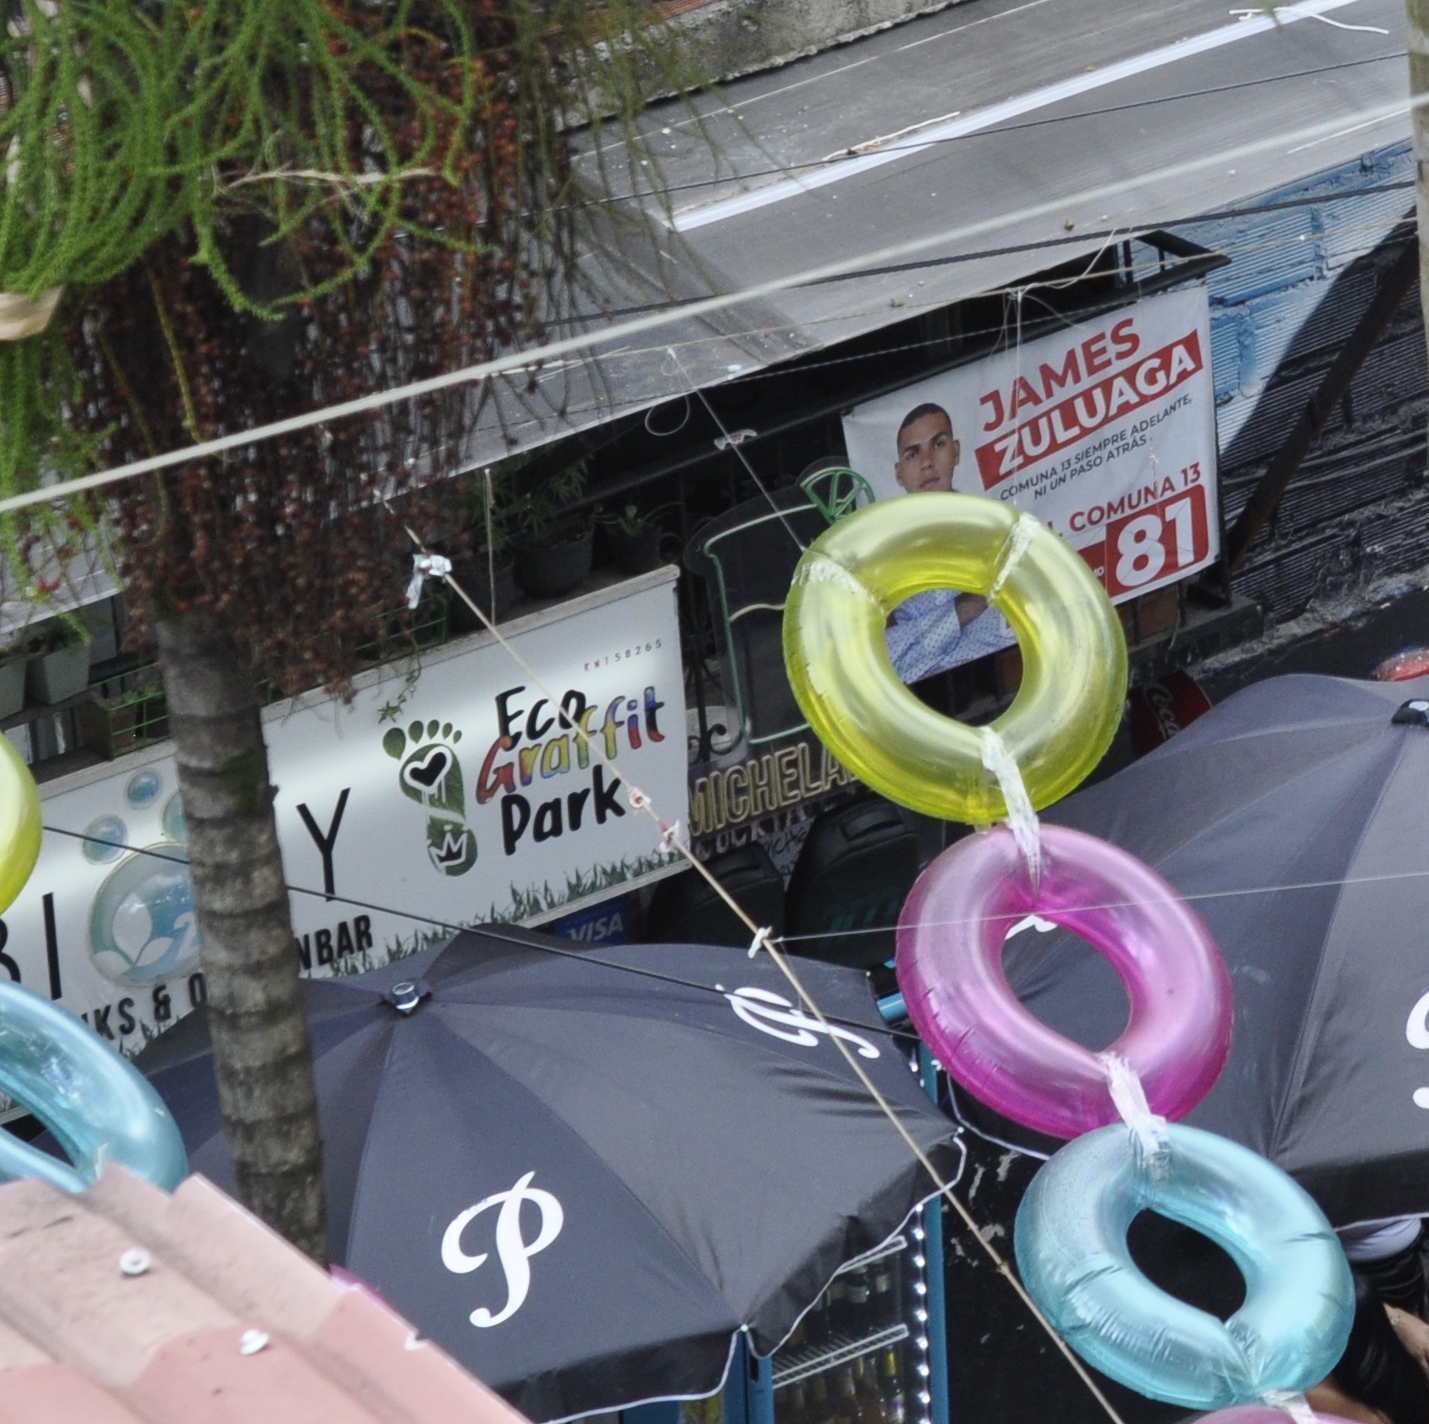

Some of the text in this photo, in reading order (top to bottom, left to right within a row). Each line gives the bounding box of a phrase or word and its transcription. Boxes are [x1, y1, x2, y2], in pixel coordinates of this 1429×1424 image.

[978, 317, 1141, 432] JAMES
[993, 343, 1197, 477] ZULUAGA
[1000, 468, 1058, 502] COMUNA
[1060, 457, 1073, 474] 13
[1075, 429, 1128, 468] SIEMPRE
[1034, 484, 1048, 501] NI
[1050, 475, 1067, 493] UN
[1070, 455, 1104, 480] PASO
[1069, 475, 1176, 533] COMUNA
[1181, 462, 1201, 487] 13
[1115, 496, 1195, 587] 81
[495, 685, 587, 752] Eco
[501, 763, 627, 856] Park
[690, 742, 860, 838] MICHELA
[566, 911, 625, 943] VISA
[152, 984, 173, 1024] &
